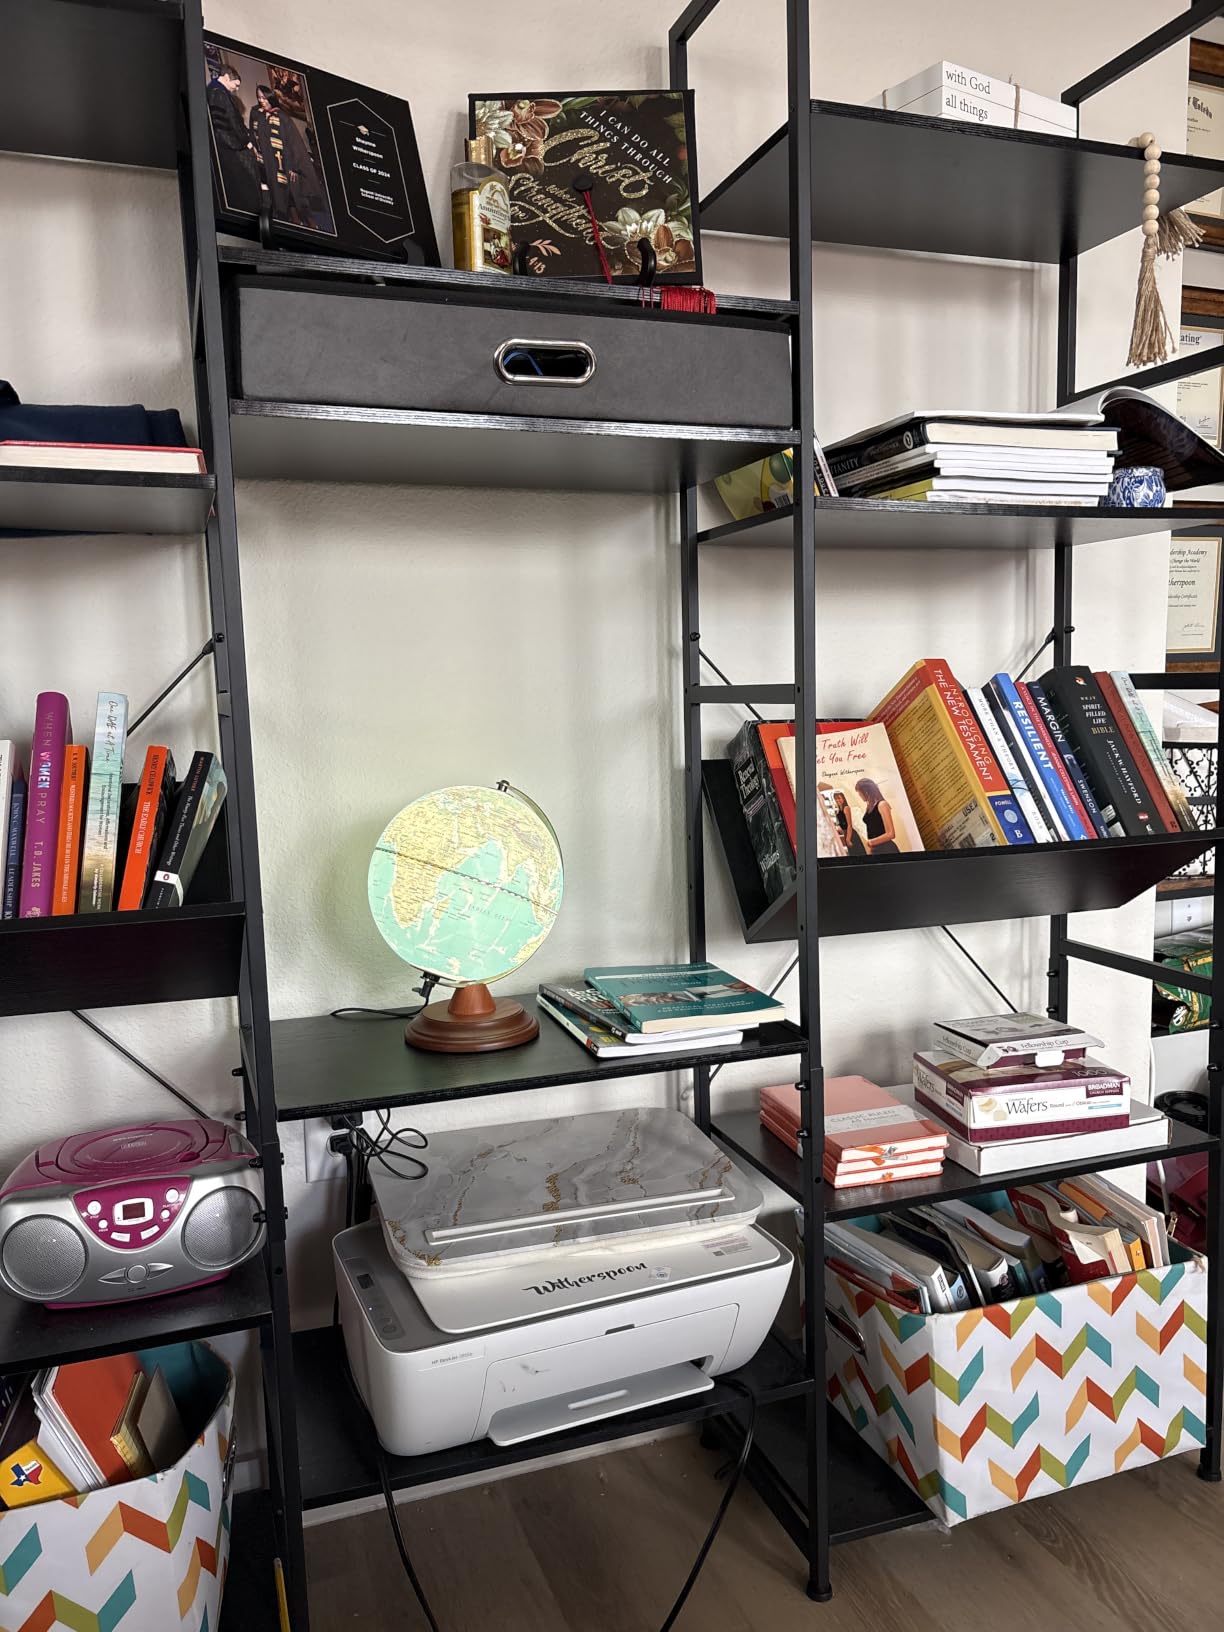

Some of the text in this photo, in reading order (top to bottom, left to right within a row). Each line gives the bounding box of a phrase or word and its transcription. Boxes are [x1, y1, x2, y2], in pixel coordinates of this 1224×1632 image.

[946, 69, 991, 95] with God
[946, 94, 989, 121] all things
[580, 111, 673, 184] THINGS THROUGH
[608, 116, 631, 134] CAN
[631, 134, 648, 148] DO
[649, 149, 670, 166] ALL
[352, 162, 369, 172] CLASS
[540, 128, 655, 199] Christ
[1180, 334, 1201, 345] ating
[1170, 548, 1186, 556] dership
[933, 669, 993, 782] THE NEW TESTAMENT
[949, 684, 992, 765] INTRODUCING
[1037, 696, 1065, 743] MARGIN
[1091, 726, 1115, 734] BIBLE
[822, 732, 869, 750] Truth Will
[1012, 701, 1054, 770] RESILIENT
[36, 712, 56, 824] WHEN WOMEN PRAY
[816, 750, 867, 764] et You Free
[1107, 739, 1120, 759] JACK
[1121, 766, 1142, 804] HAYFORD
[1077, 779, 1097, 814] SWENSON
[134, 801, 150, 854] THE EARLY CHURCH
[1014, 829, 1023, 838] B
[760, 850, 780, 872] Williams
[6, 868, 15, 908] LEADERSHIP
[31, 862, 42, 888] JAKES
[1020, 1040, 1054, 1049] Fellowship
[1087, 1082, 1120, 1091] BROADMAN
[1005, 1097, 1048, 1115] Wafers
[521, 1262, 648, 1296] Witherspoon
